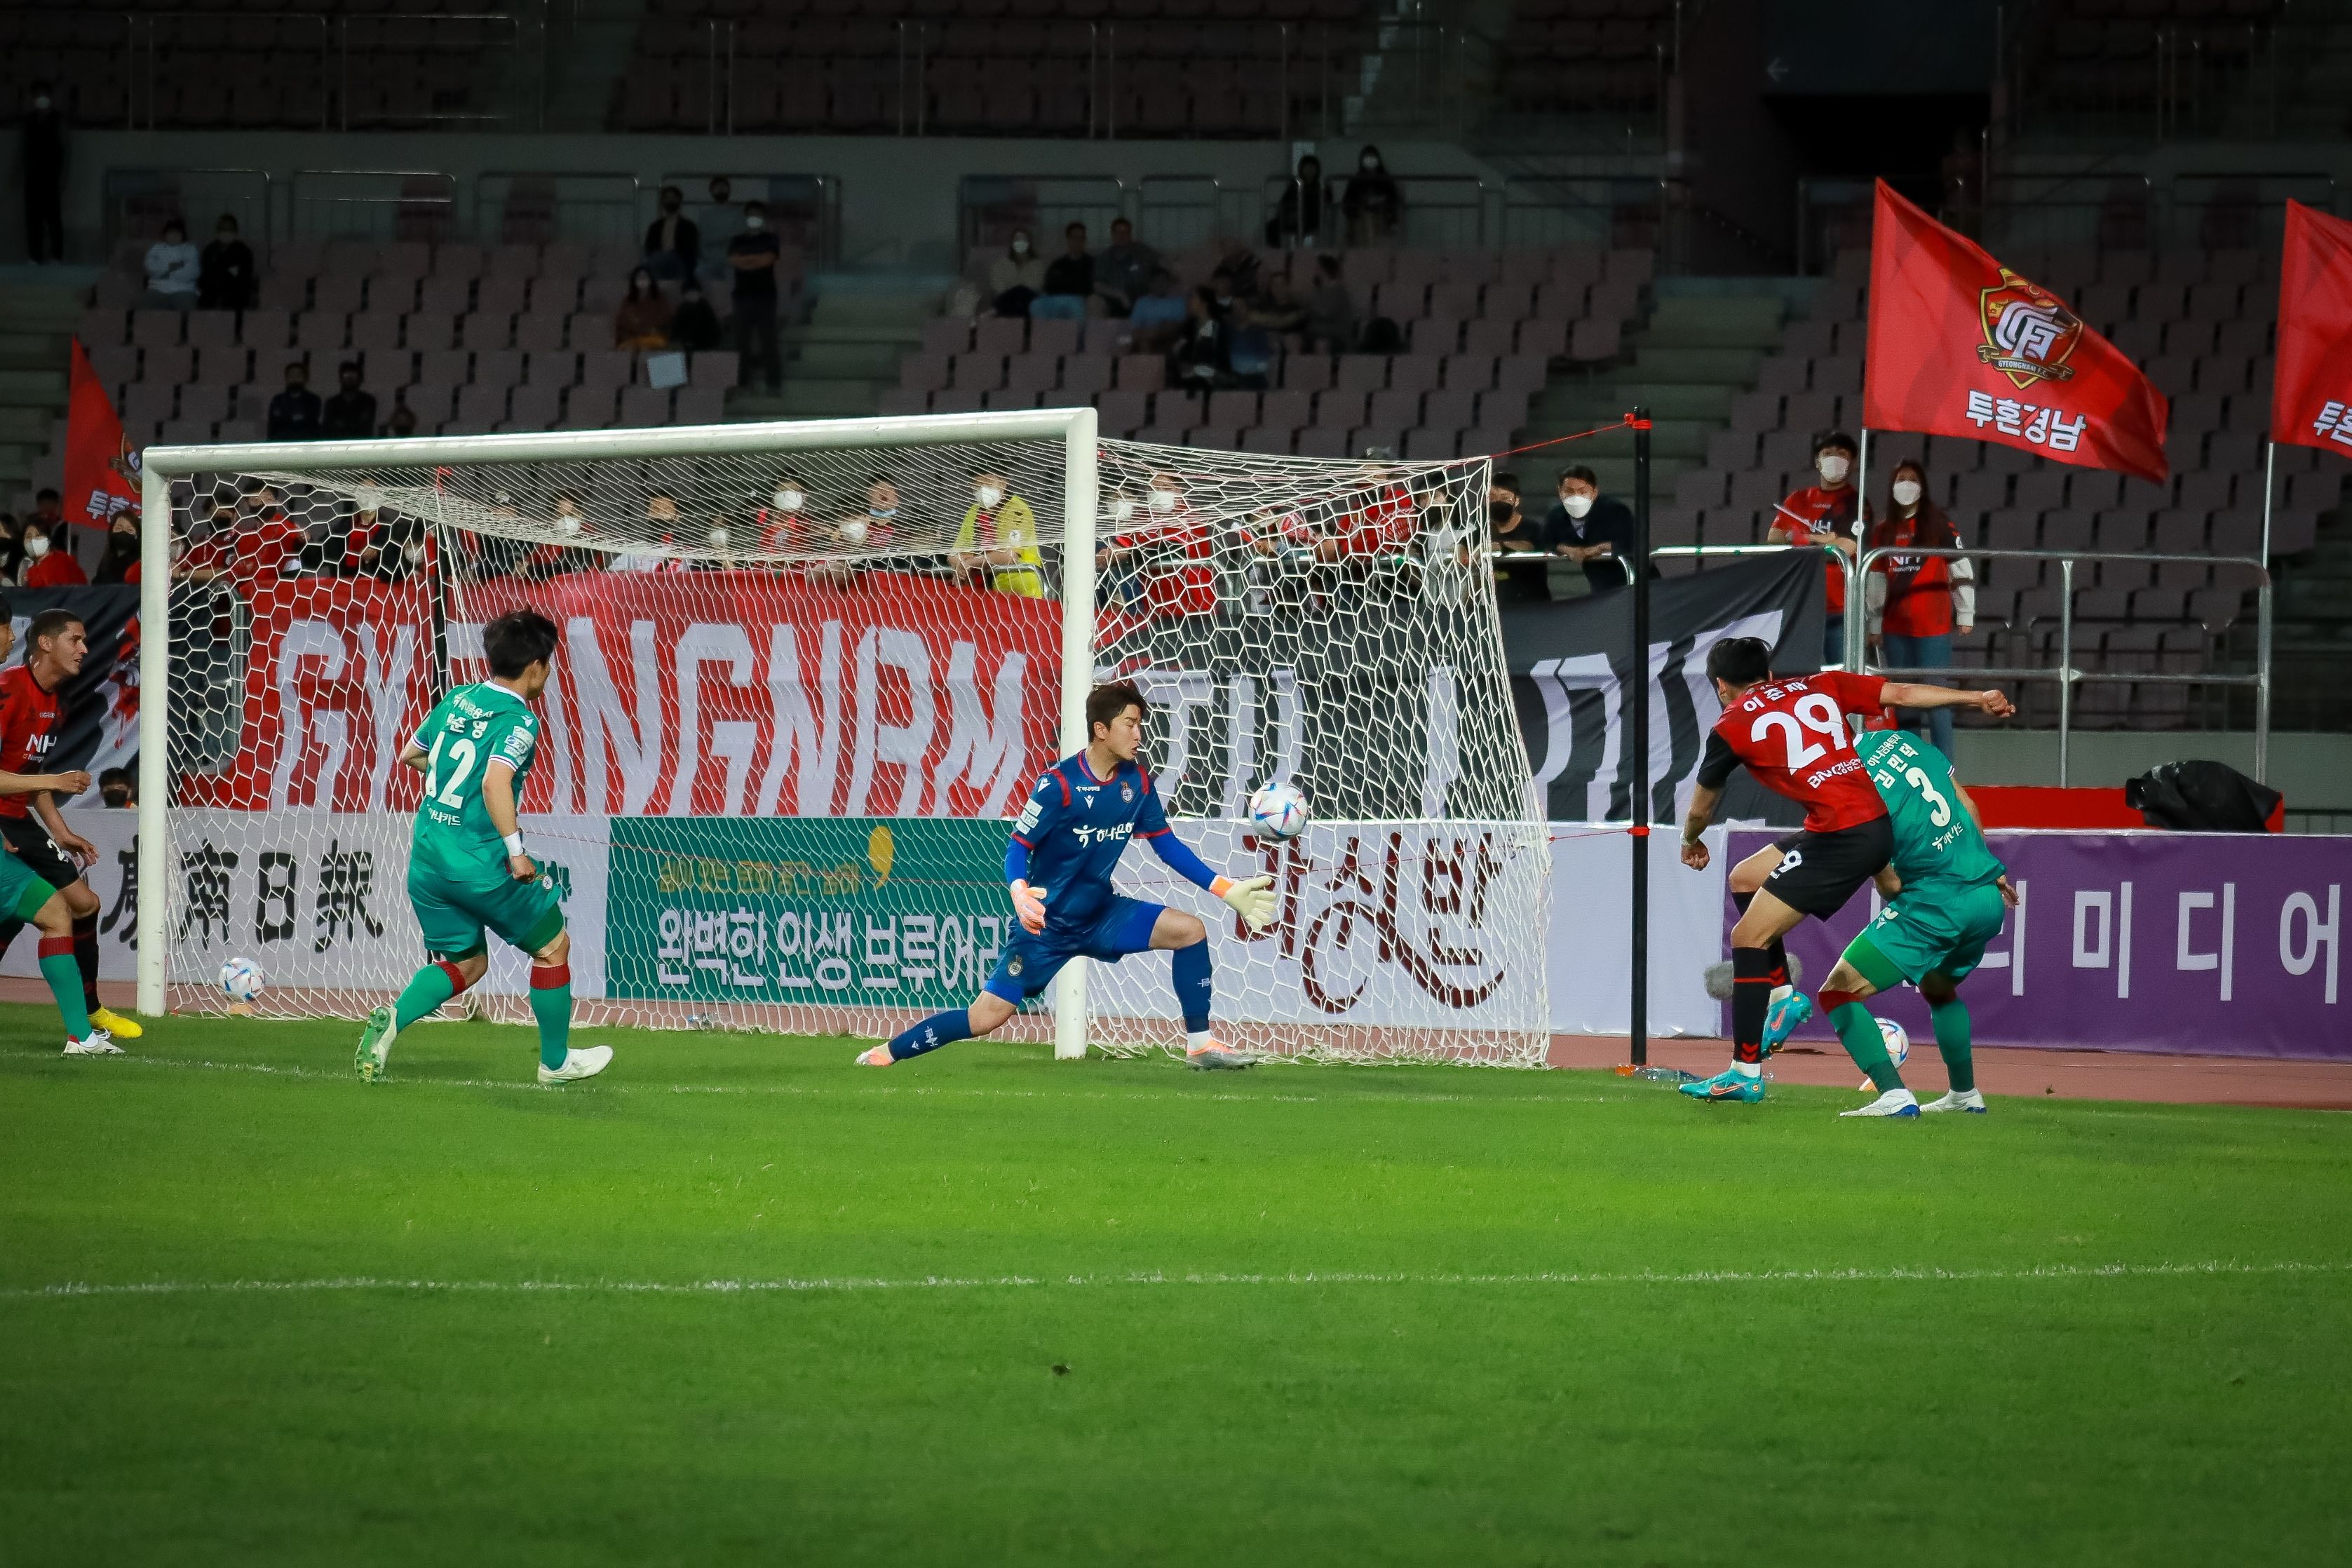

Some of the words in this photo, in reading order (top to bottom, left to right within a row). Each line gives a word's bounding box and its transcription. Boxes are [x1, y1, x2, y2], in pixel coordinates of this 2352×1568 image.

[1966, 389, 2087, 451] 투혼경남
[425, 731, 476, 809] 12
[1750, 693, 1848, 776] 29
[1905, 766, 1951, 827] 3
[658, 907, 767, 986] 완벽한
[777, 910, 851, 989] 인생
